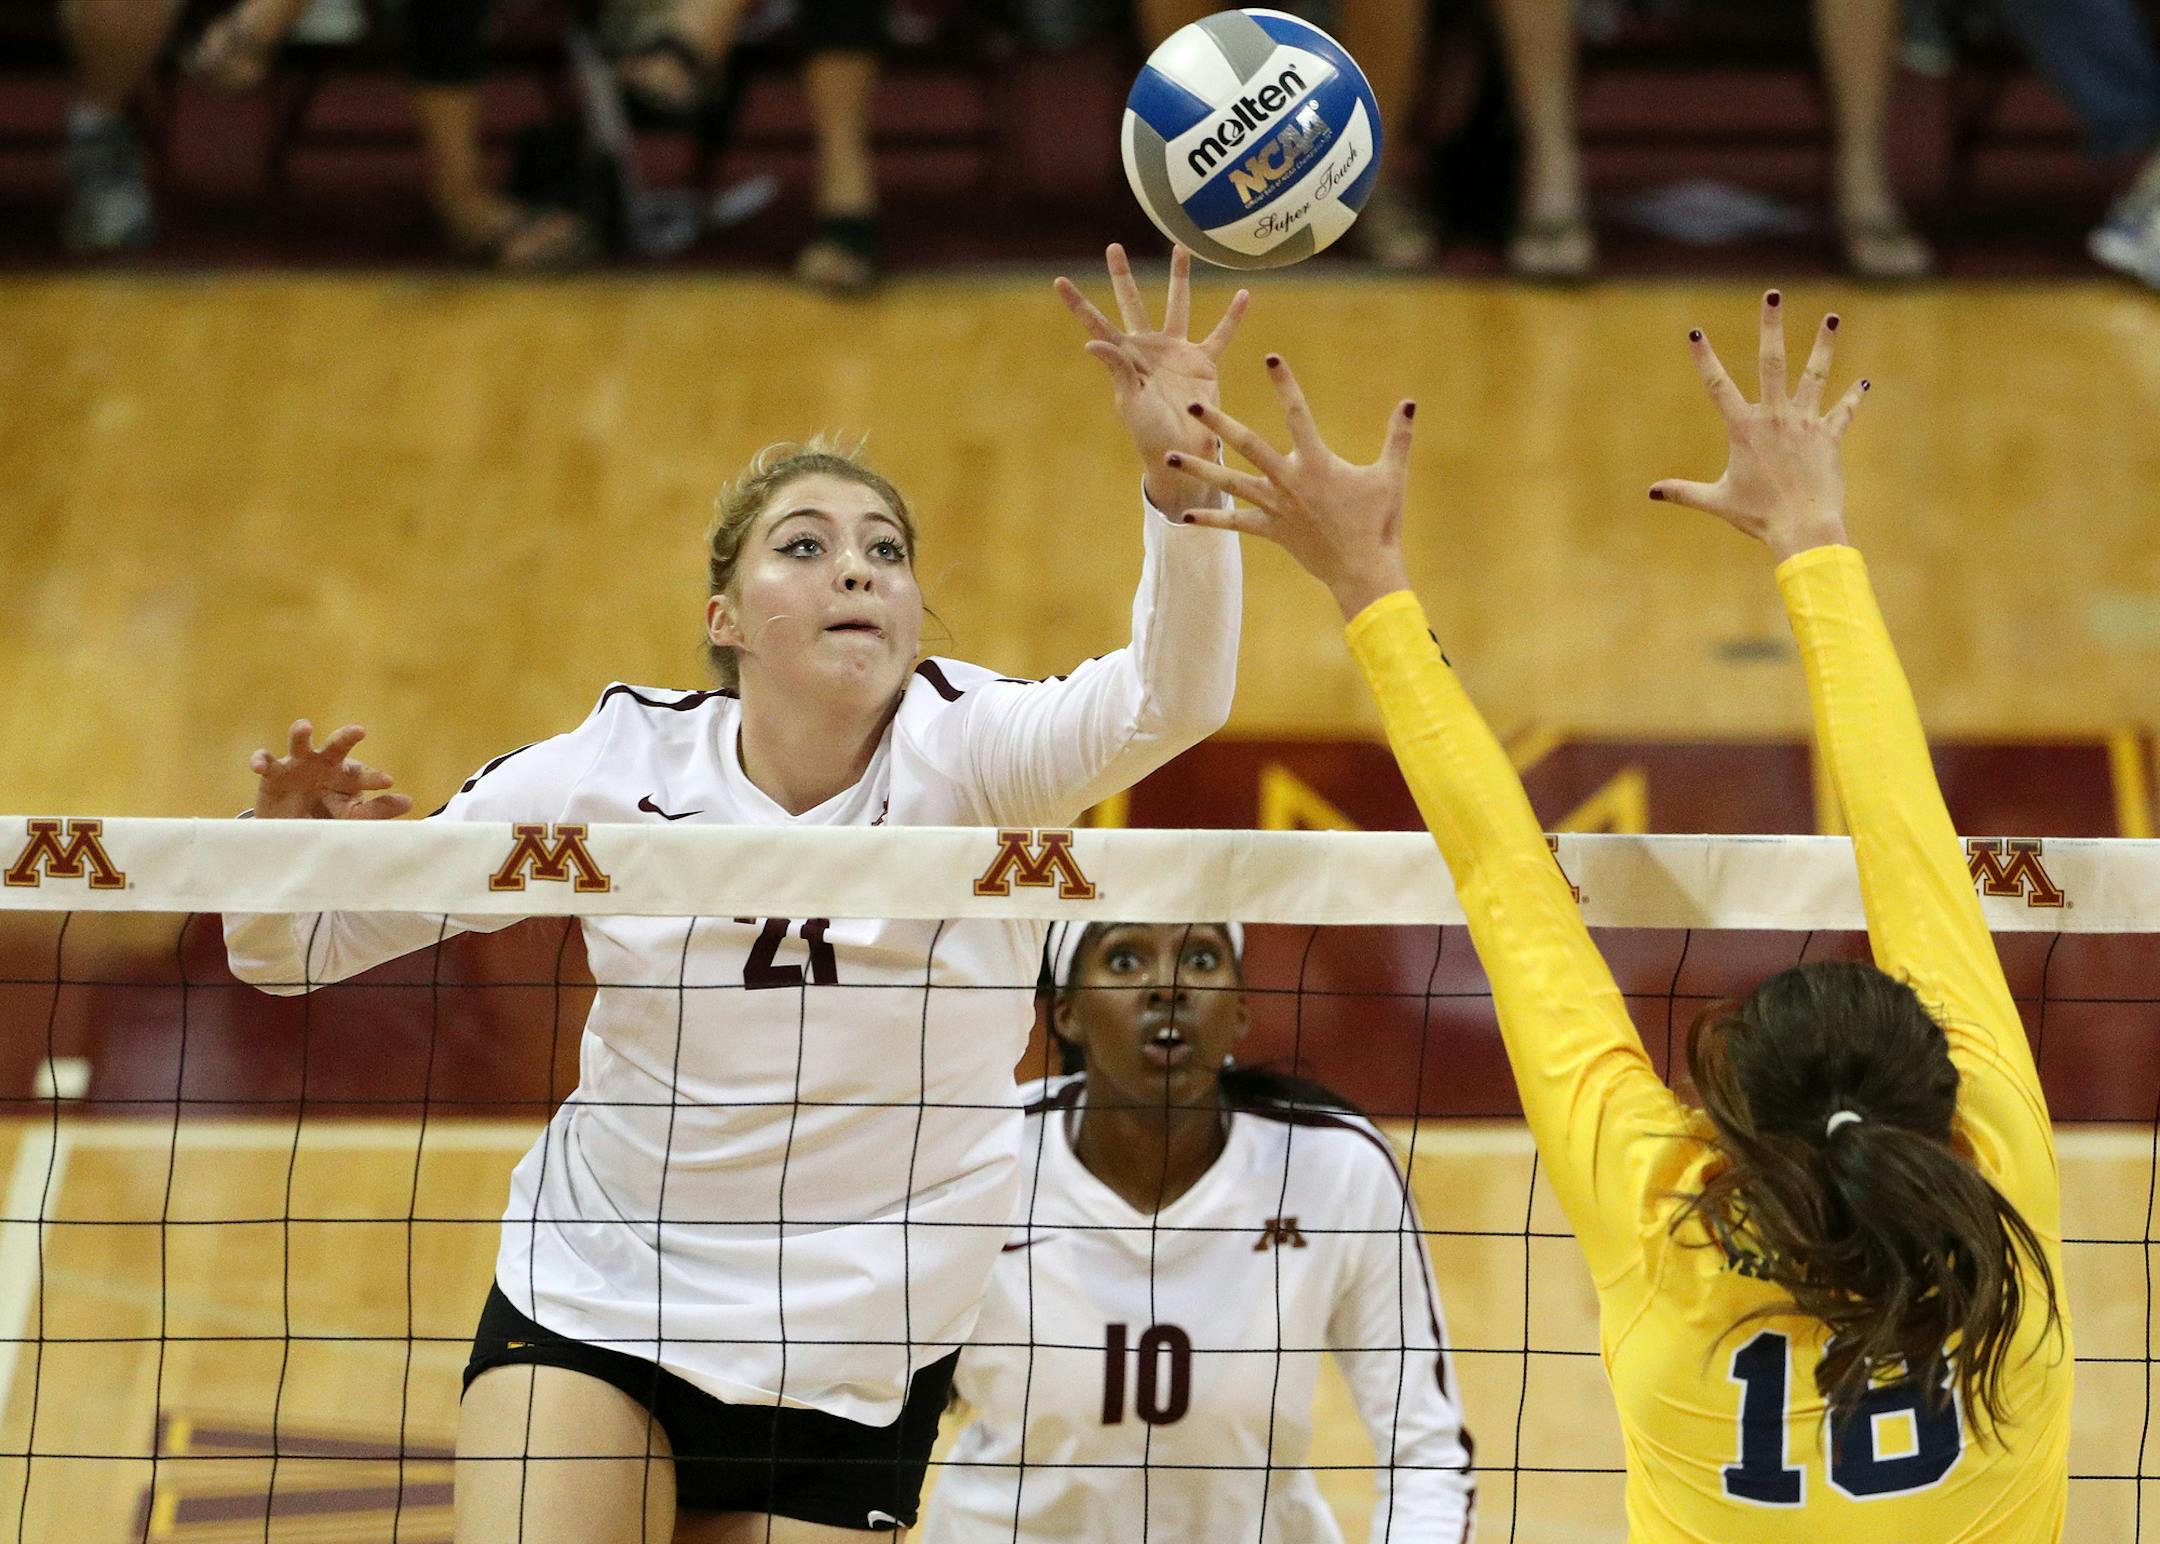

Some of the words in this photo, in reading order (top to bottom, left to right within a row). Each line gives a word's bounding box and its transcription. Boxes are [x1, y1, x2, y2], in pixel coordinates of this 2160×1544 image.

[1188, 66, 1307, 178] molten
[1228, 106, 1330, 205] NCAA
[1254, 202, 1311, 239] Super
[1315, 142, 1358, 200] Touch
[4, 819, 126, 890] M
[489, 823, 611, 893] M
[973, 829, 1096, 899] M
[1102, 1323, 1191, 1427] 10
[1721, 1329, 1965, 1508] 18
